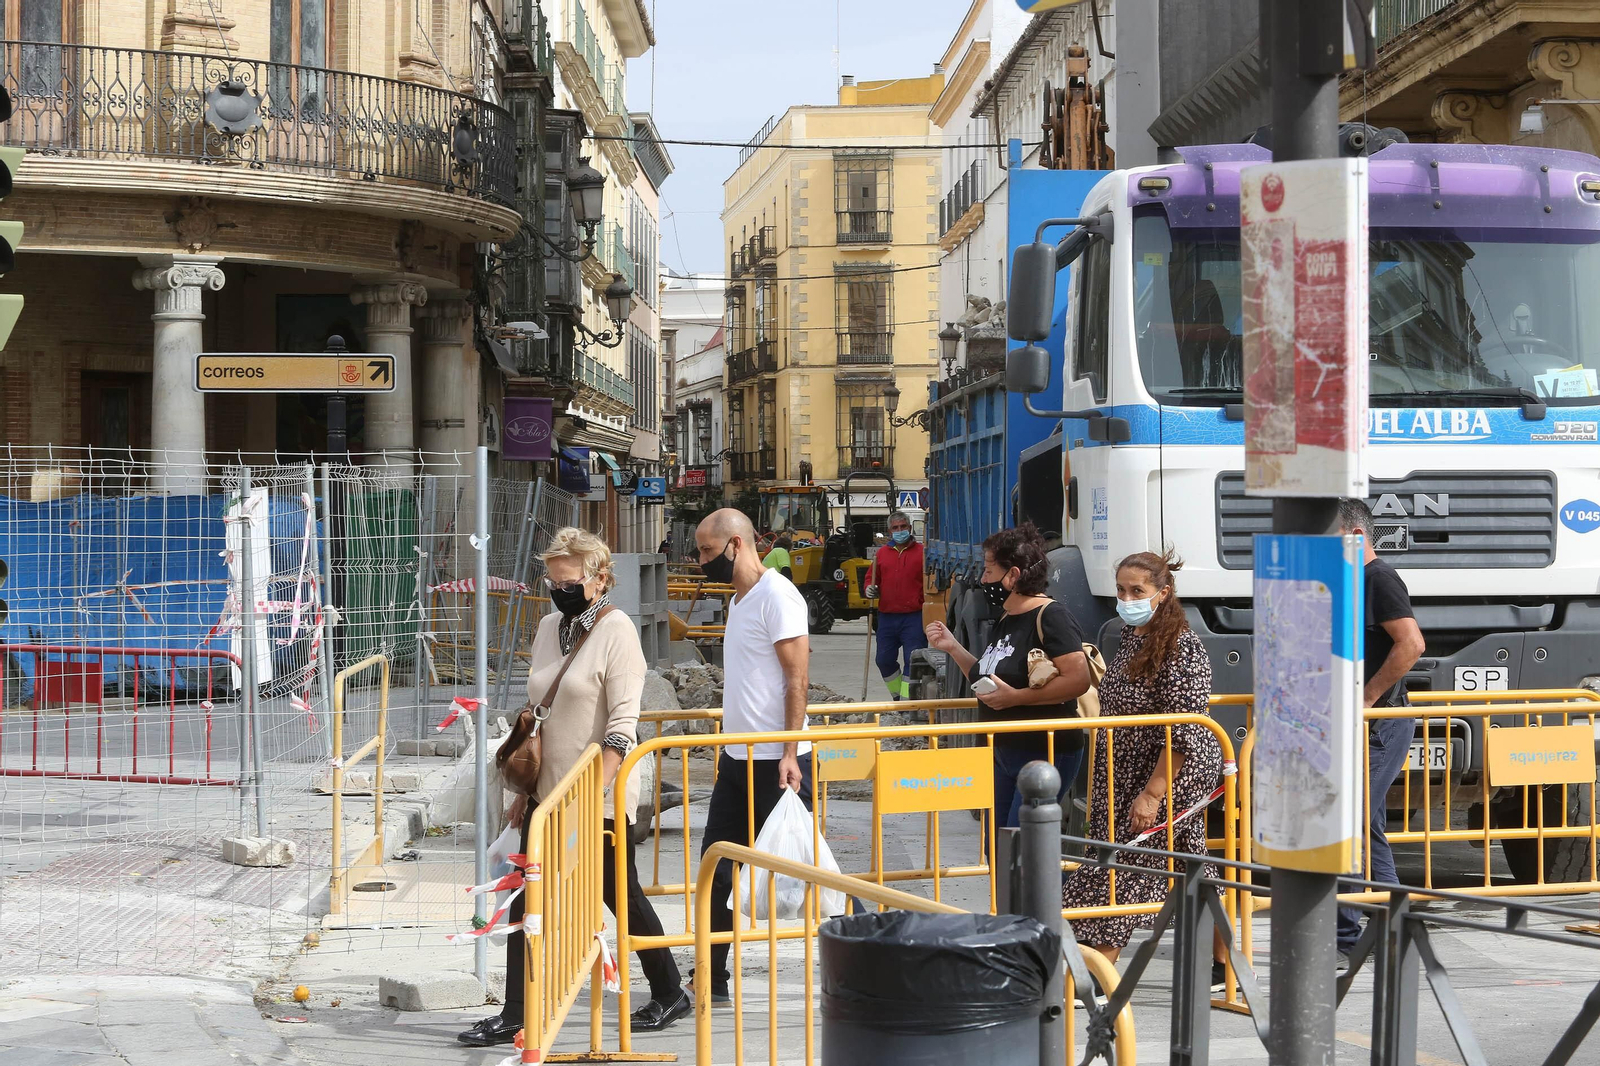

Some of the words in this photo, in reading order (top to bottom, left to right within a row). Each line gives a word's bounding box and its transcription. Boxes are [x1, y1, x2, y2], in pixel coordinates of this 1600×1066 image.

[1306, 252, 1336, 262] zona
[203, 367, 265, 378] correos
[1410, 409, 1492, 434] ALBA
[1371, 493, 1449, 516] AN
[1564, 510, 1575, 521] V
[1577, 510, 1600, 522] 045
[835, 571, 843, 579] 20
[817, 748, 858, 762] ajerez
